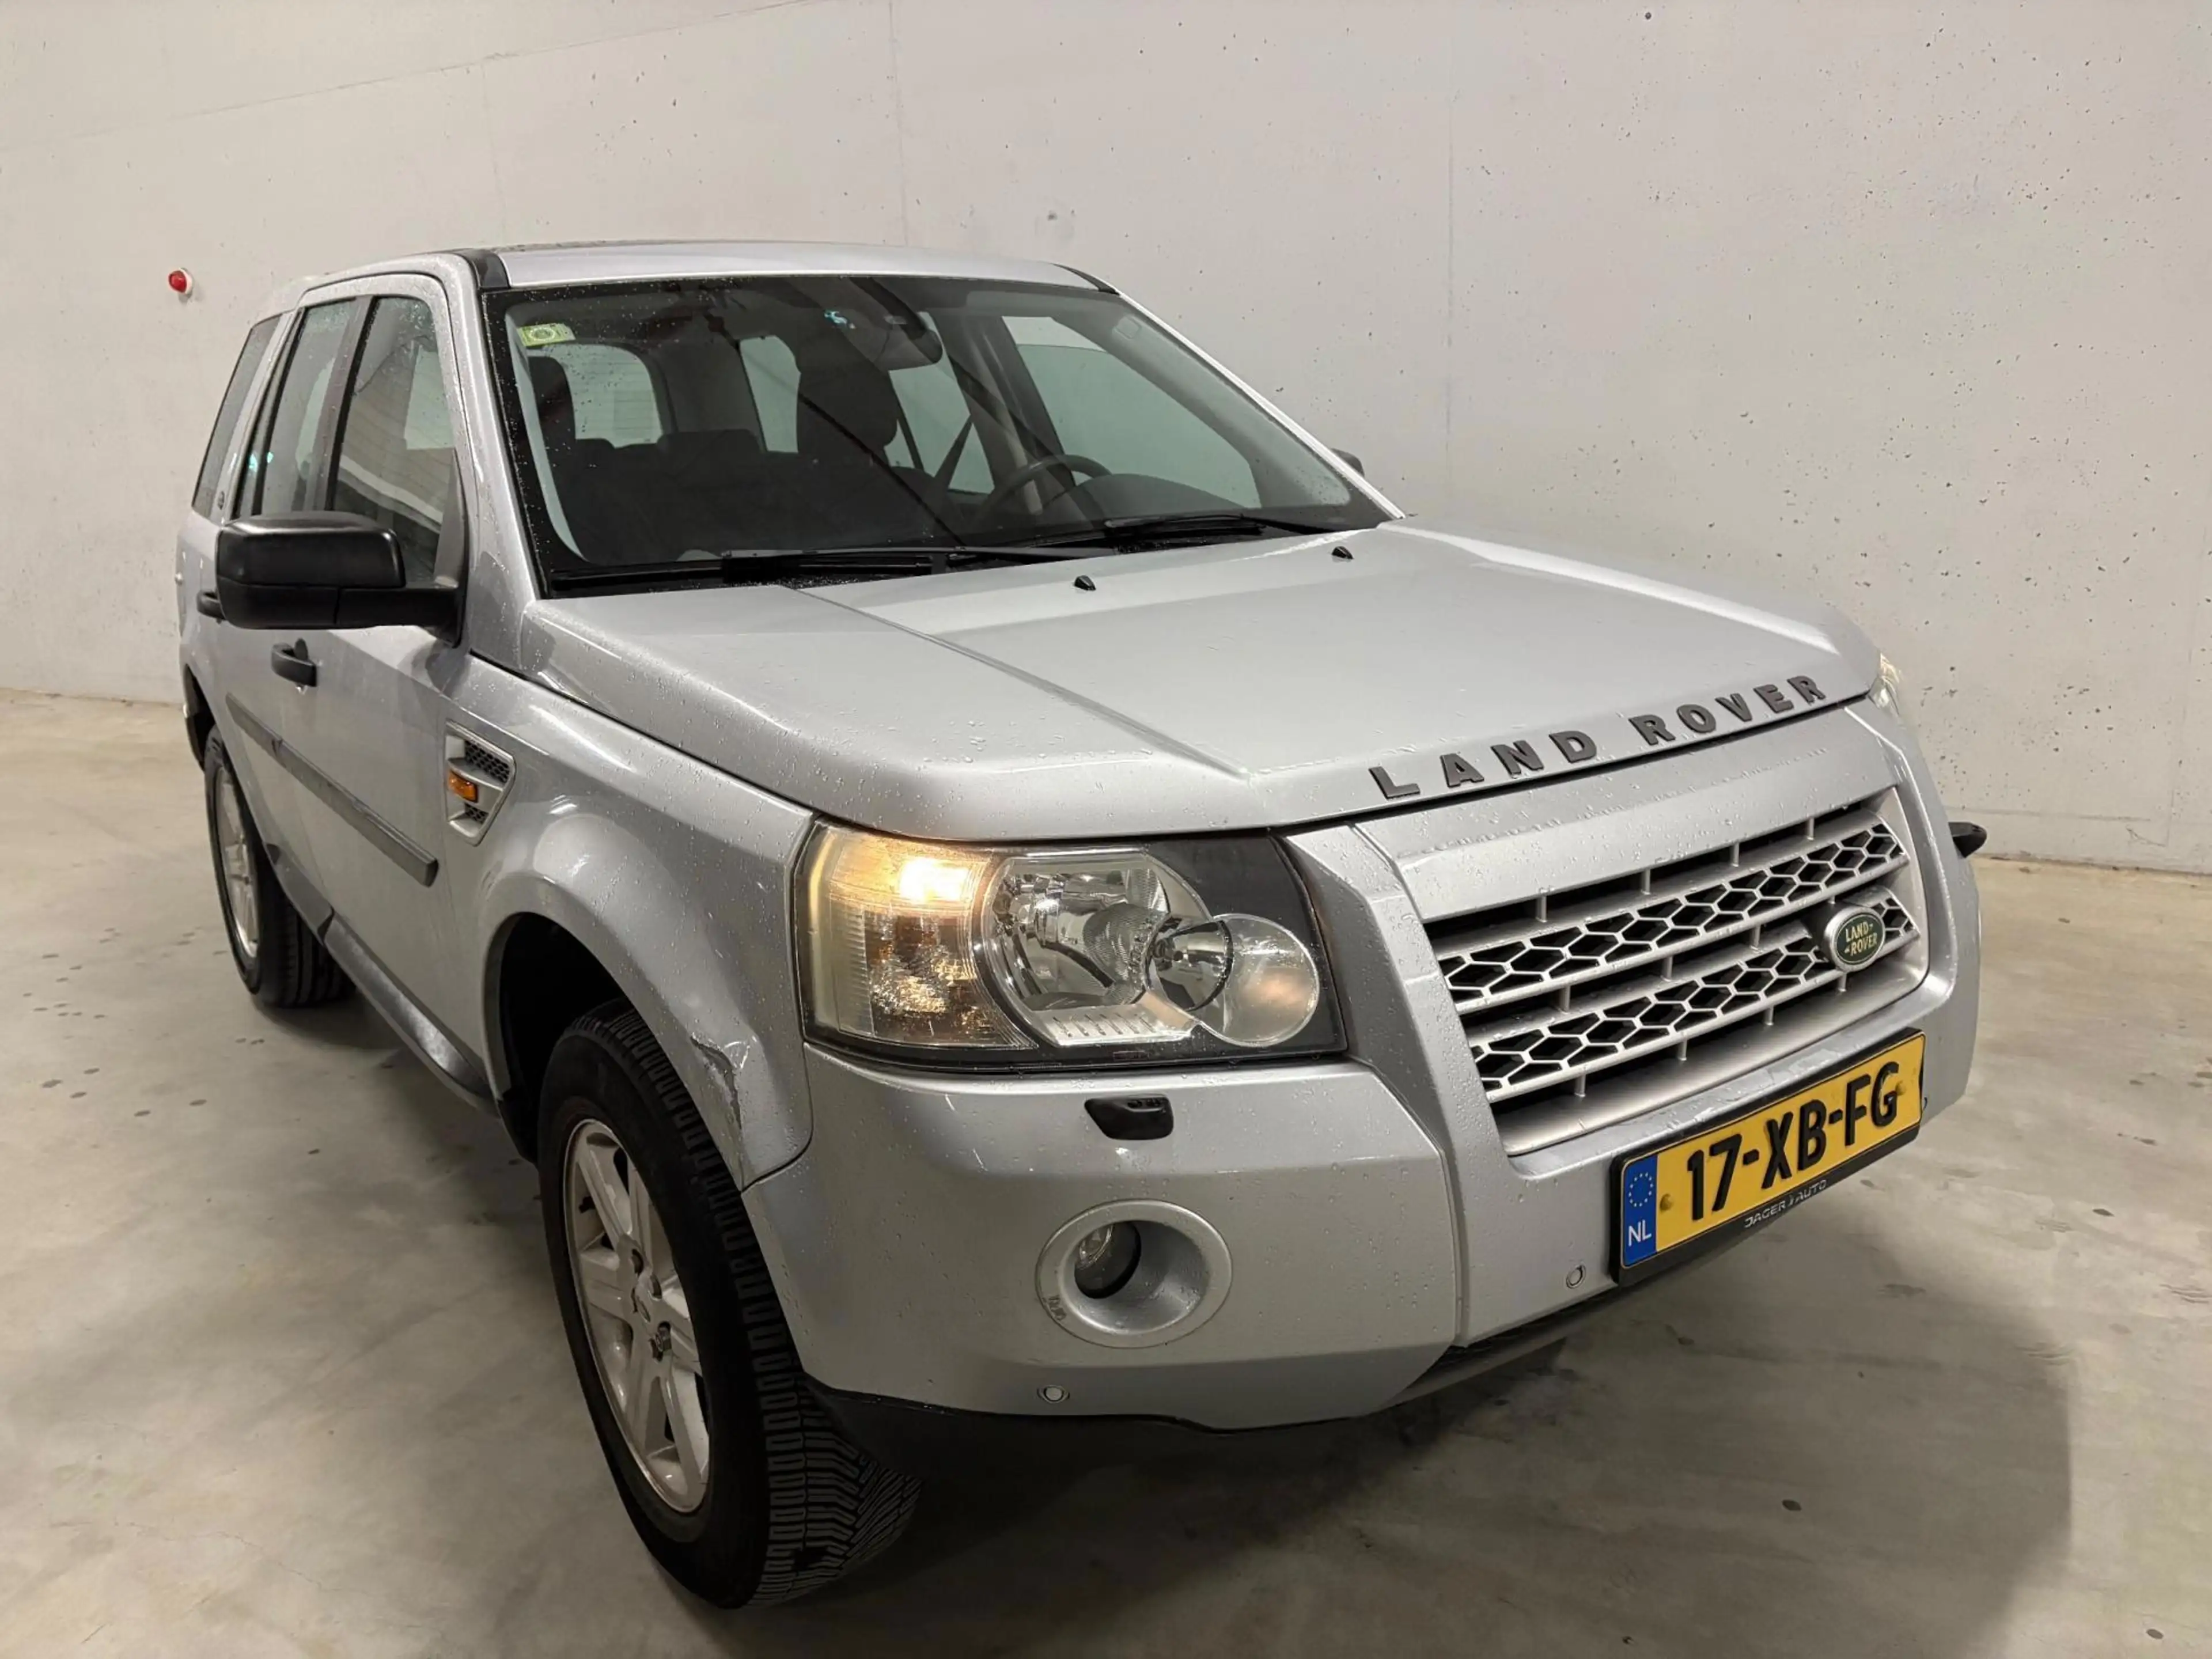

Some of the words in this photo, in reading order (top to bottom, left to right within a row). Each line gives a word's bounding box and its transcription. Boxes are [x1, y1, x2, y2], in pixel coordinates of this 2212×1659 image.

[1369, 730, 1597, 800] LAND
[1629, 676, 1826, 745] ROVER
[1846, 922, 1869, 942] LAND
[1851, 933, 1877, 956] ROVER
[1687, 1061, 1900, 1221] 17-XB-FG
[1744, 1200, 1786, 1228] JAGER
[1794, 1179, 1827, 1205] AUTO
[1628, 1220, 1652, 1247] NL
